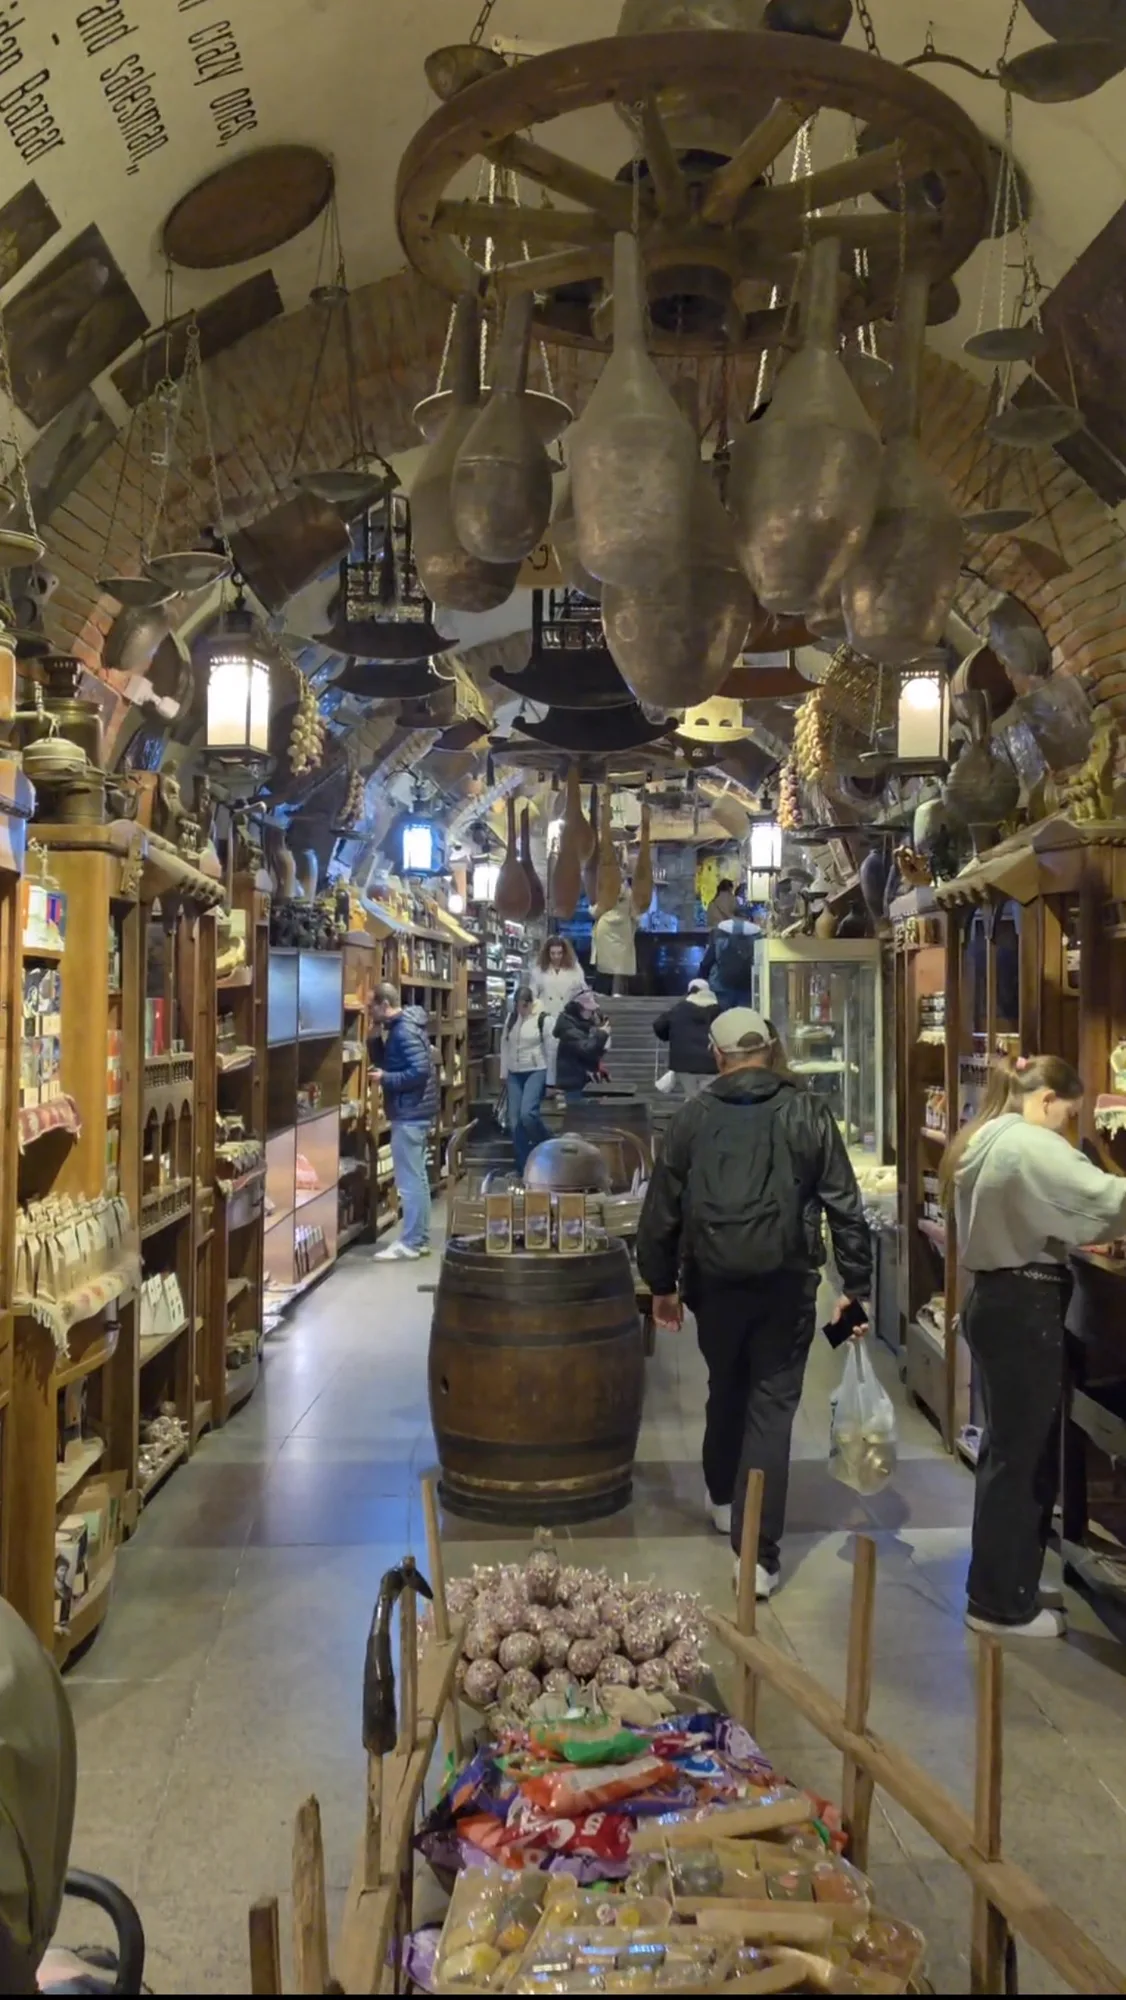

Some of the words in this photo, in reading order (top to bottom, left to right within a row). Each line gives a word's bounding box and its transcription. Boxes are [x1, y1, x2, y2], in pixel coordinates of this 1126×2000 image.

[76, 0, 139, 57] and
[188, 20, 244, 86] crazy
[0, 68, 66, 166] Bazaar
[209, 87, 258, 148] ones,
